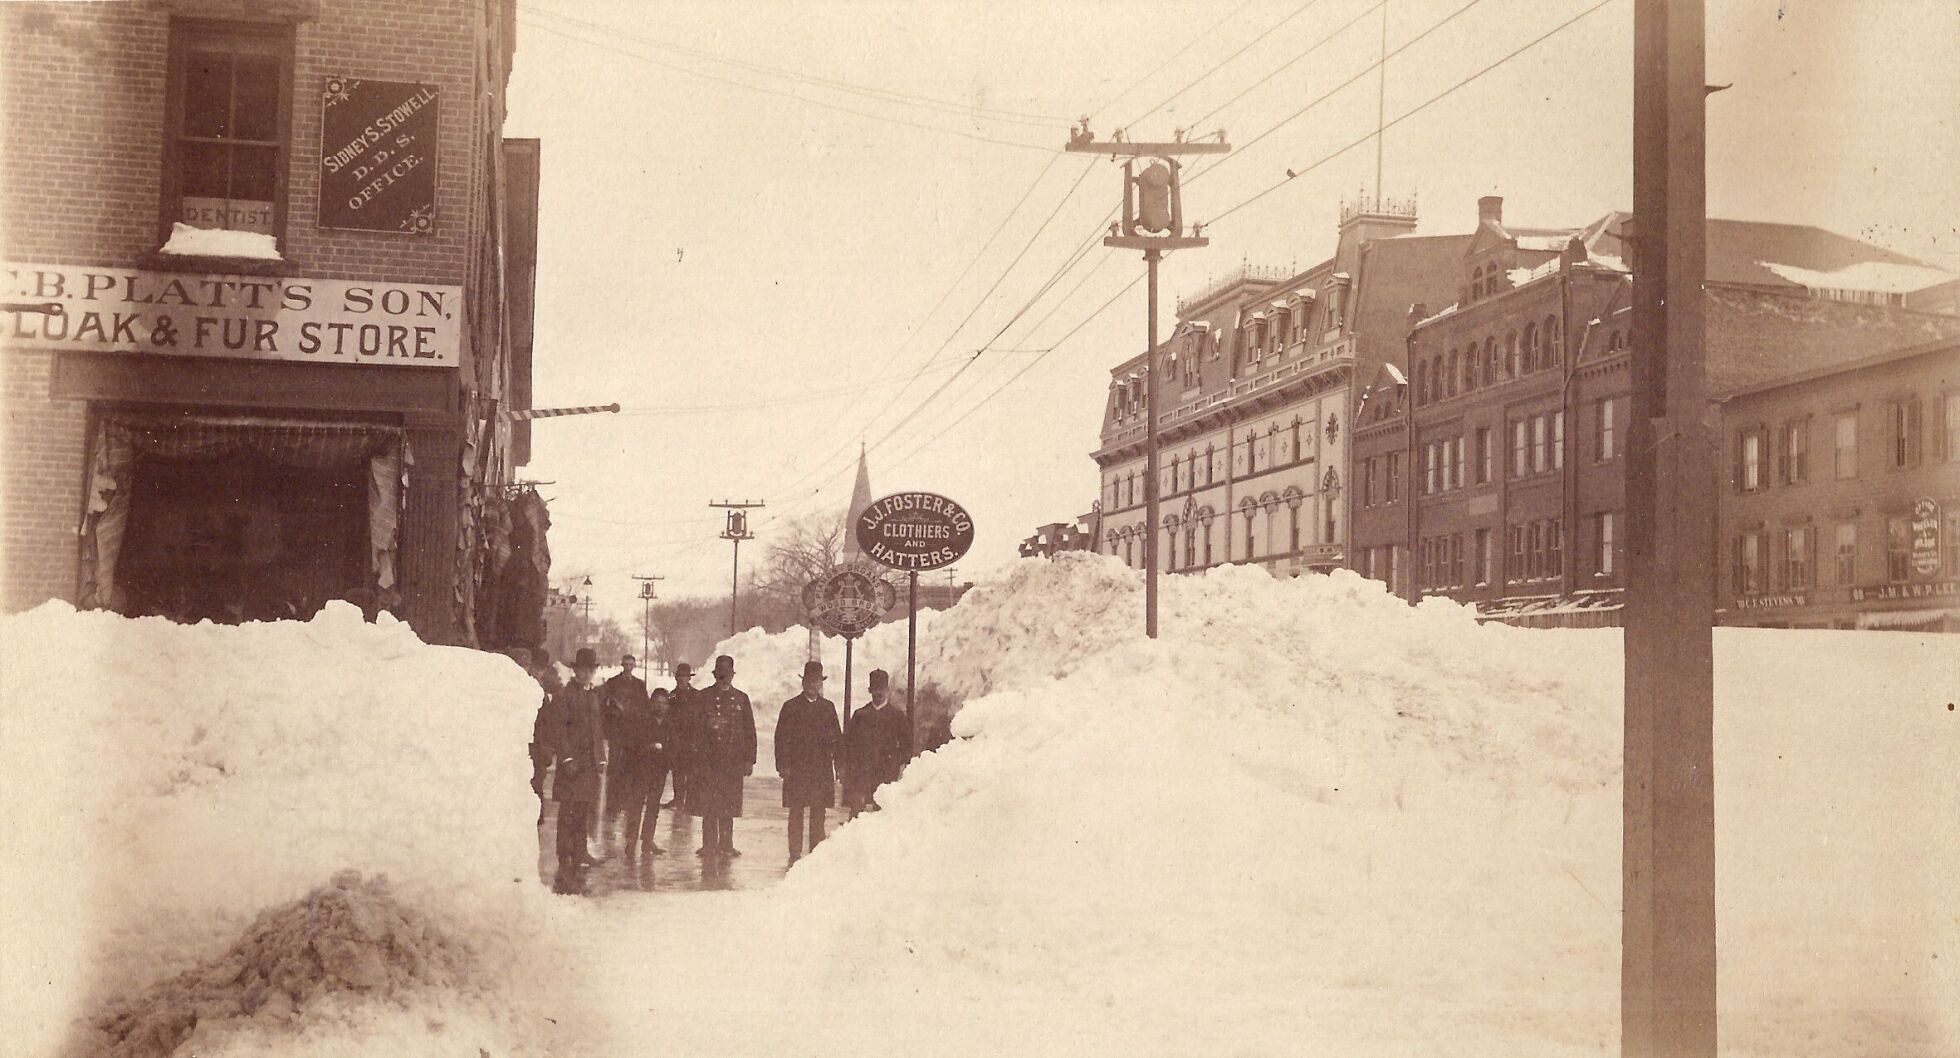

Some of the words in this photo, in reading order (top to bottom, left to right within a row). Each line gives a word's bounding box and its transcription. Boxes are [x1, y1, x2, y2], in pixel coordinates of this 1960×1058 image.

[323, 134, 369, 173] SIDNEY
[349, 154, 424, 210] OFFICE.
[343, 287, 451, 321] SON,
[0, 309, 141, 343] LOAK
[150, 314, 178, 347] &
[193, 315, 280, 352] FUR
[298, 321, 444, 360] STORE.
[883, 523, 950, 539] CLOTHIERS
[904, 540, 926, 548] AND
[870, 541, 959, 567] HATTERS.
[846, 564, 881, 588] ORGANS
[820, 599, 846, 612] WOOD
